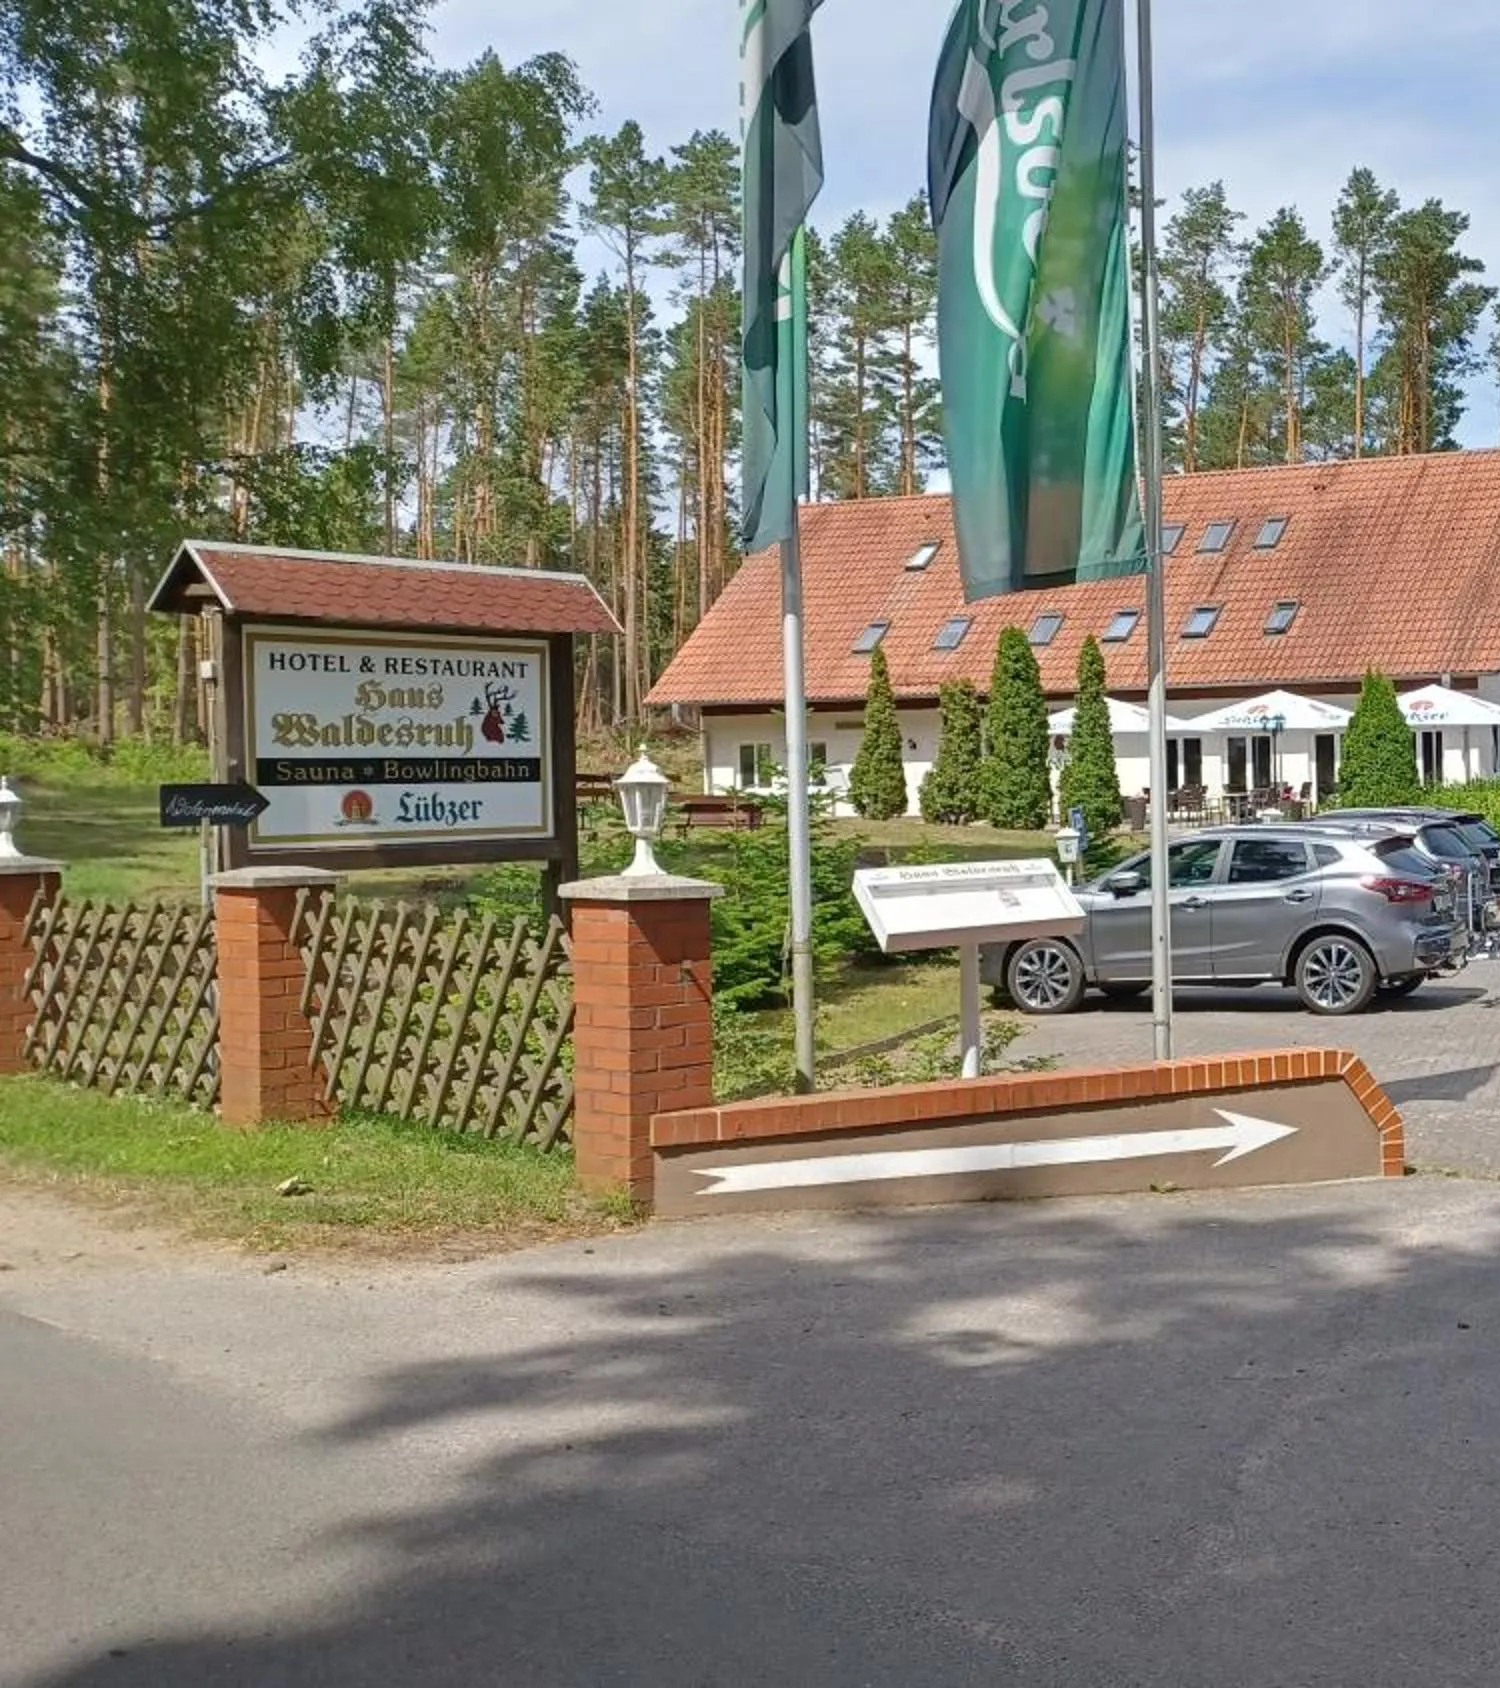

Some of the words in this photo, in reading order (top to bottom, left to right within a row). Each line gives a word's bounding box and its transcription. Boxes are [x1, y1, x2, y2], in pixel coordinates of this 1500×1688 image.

[269, 652, 351, 672] HOTEL
[359, 655, 376, 673] &
[384, 657, 528, 678] RESTAURANT
[354, 679, 444, 712] Haus
[271, 712, 474, 755] Waldesruh
[276, 760, 355, 781] Sauna
[383, 759, 530, 783] Bowlingbahn
[395, 791, 483, 826] Lübzer
